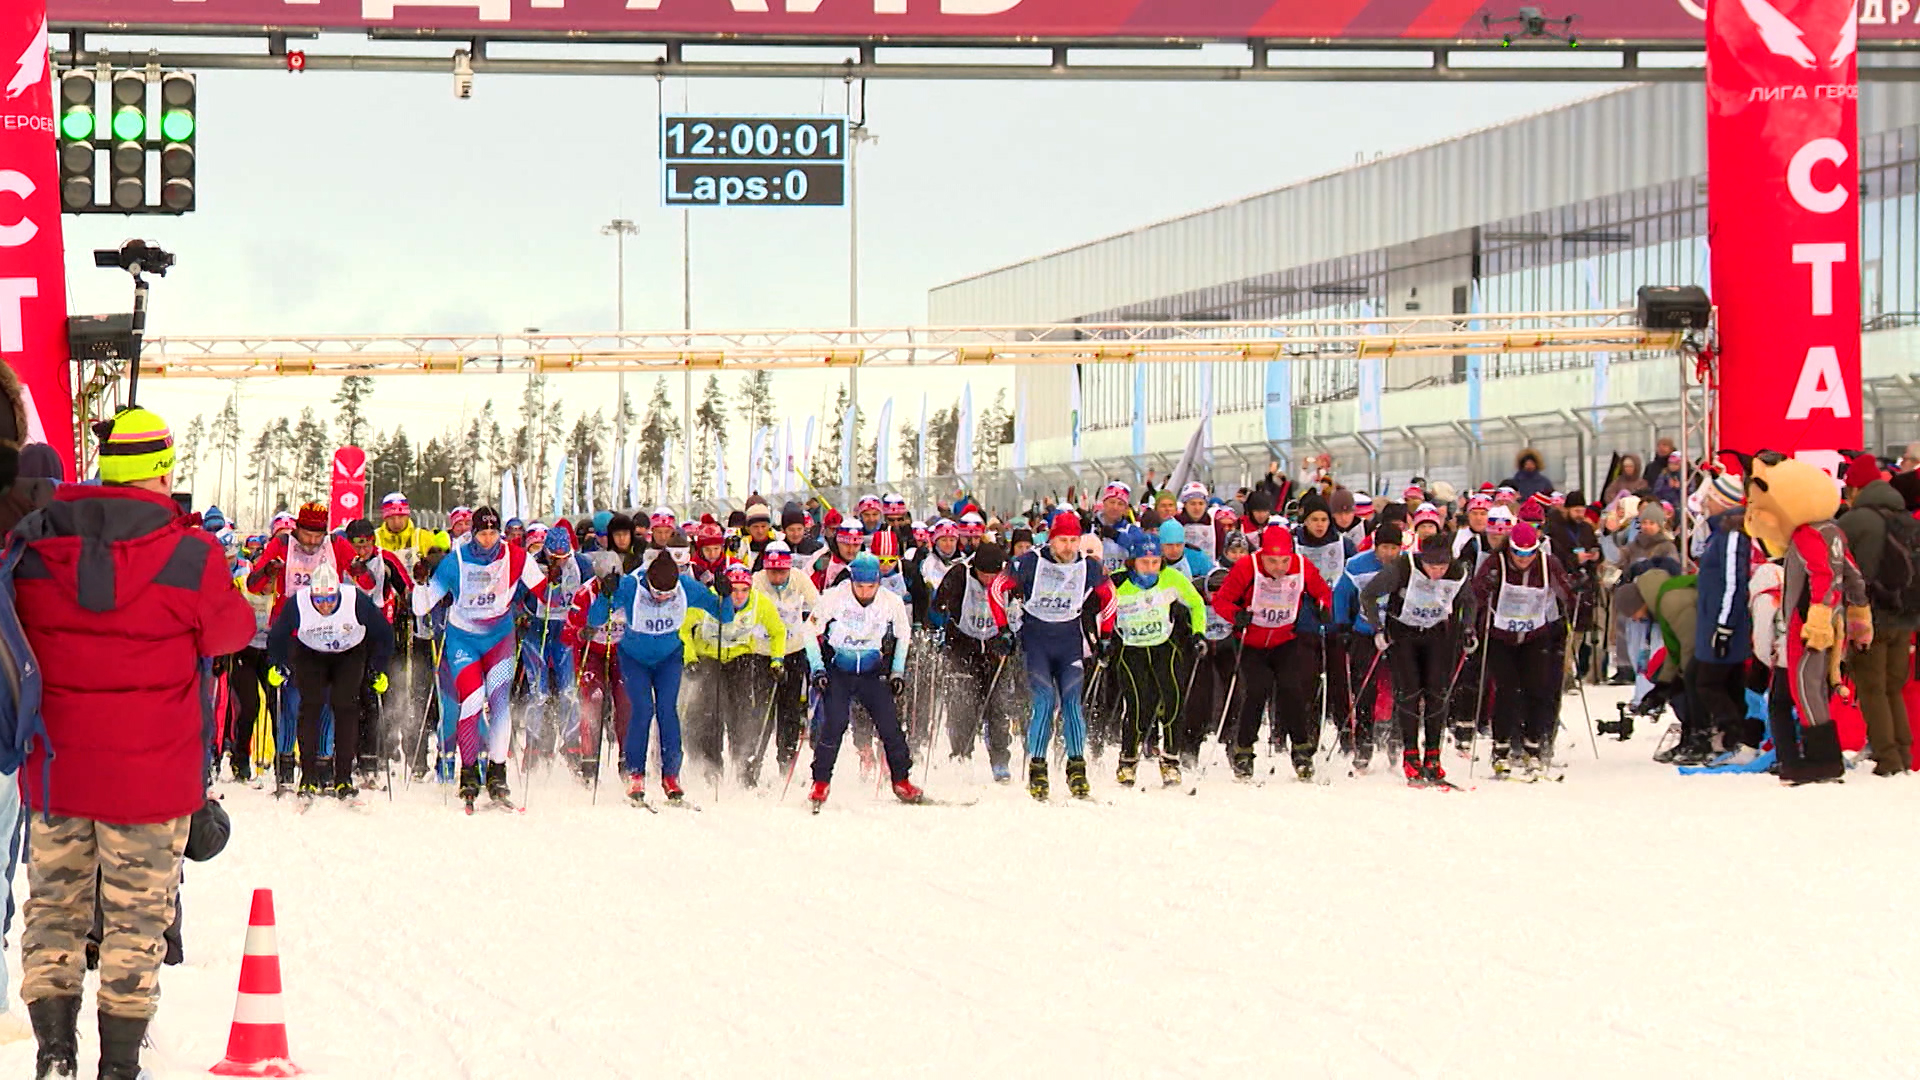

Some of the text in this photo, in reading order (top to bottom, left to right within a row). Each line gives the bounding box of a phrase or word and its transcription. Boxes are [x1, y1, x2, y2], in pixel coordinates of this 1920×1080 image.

[1747, 85, 1808, 101] ЛИГА
[0, 114, 54, 132] ЕРОЕВ
[667, 123, 838, 156] 12:00:01
[667, 169, 808, 207] Laps:0
